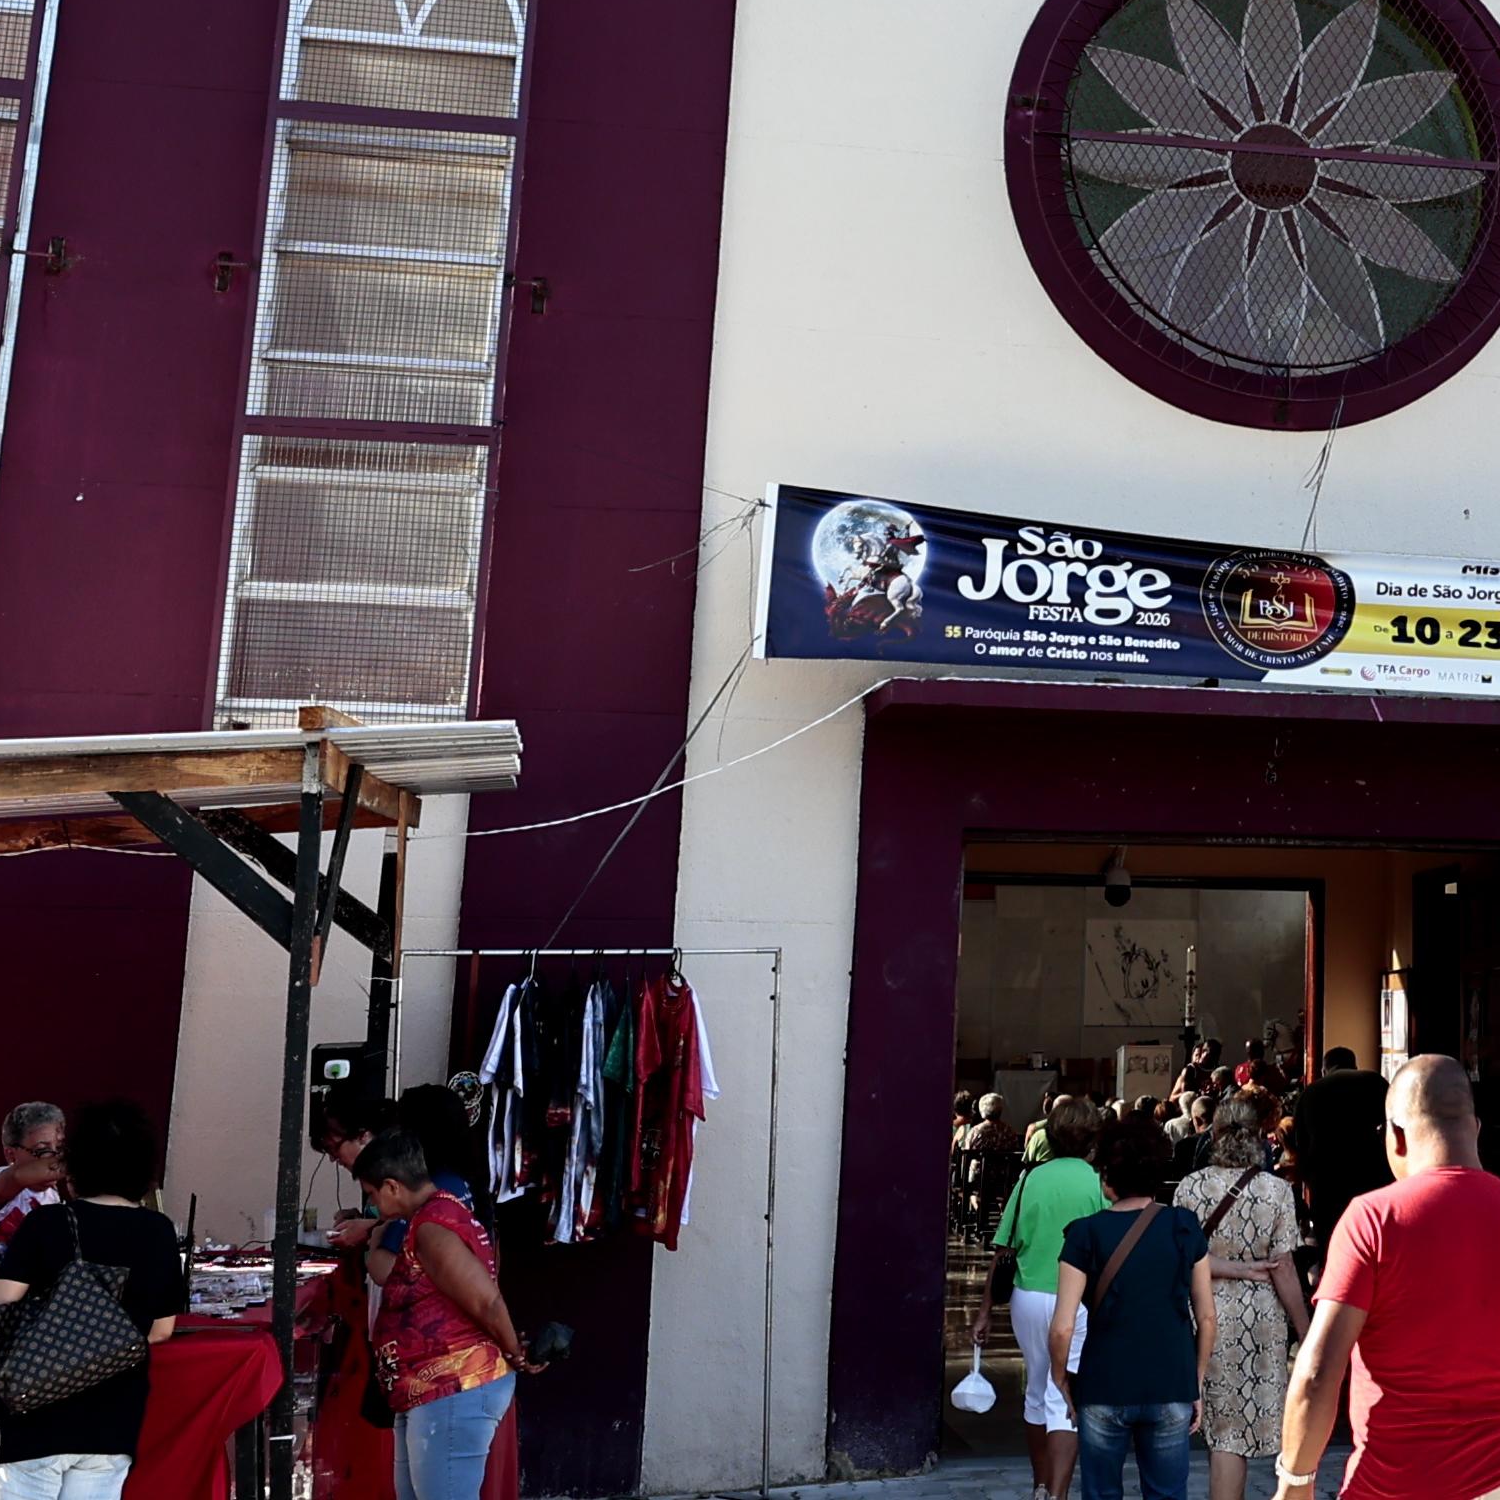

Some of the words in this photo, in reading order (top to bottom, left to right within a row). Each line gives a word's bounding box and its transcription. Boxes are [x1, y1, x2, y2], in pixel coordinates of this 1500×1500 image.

[1017, 526, 1103, 560] São
[957, 537, 1173, 626] Jorge
[1376, 581, 1402, 597] Dia
[1407, 583, 1428, 598] de
[1432, 584, 1463, 600] São
[1028, 604, 1084, 623] FESTA
[1135, 611, 1171, 627] 2026
[944, 625, 962, 638] 55
[965, 627, 1021, 644] Paróquia
[1023, 631, 1047, 643] São
[1049, 631, 1086, 646] Jorge
[1088, 636, 1096, 645] e
[1098, 633, 1122, 647] São
[1124, 635, 1181, 650] Benedito
[1247, 631, 1262, 641] DE
[1373, 624, 1389, 634] De
[1390, 615, 1441, 645] 10
[1445, 629, 1454, 639] a
[974, 643, 986, 655] O
[989, 646, 1024, 657] amor
[1027, 645, 1043, 658] de
[1046, 646, 1088, 660] Cristo
[1090, 650, 1113, 661] nos
[1116, 651, 1149, 663] uniu.
[1259, 654, 1296, 665] CRISTO
[1376, 664, 1396, 675] TFA
[1399, 665, 1431, 677] Cargo
[1438, 671, 1480, 683] MATRIZ
